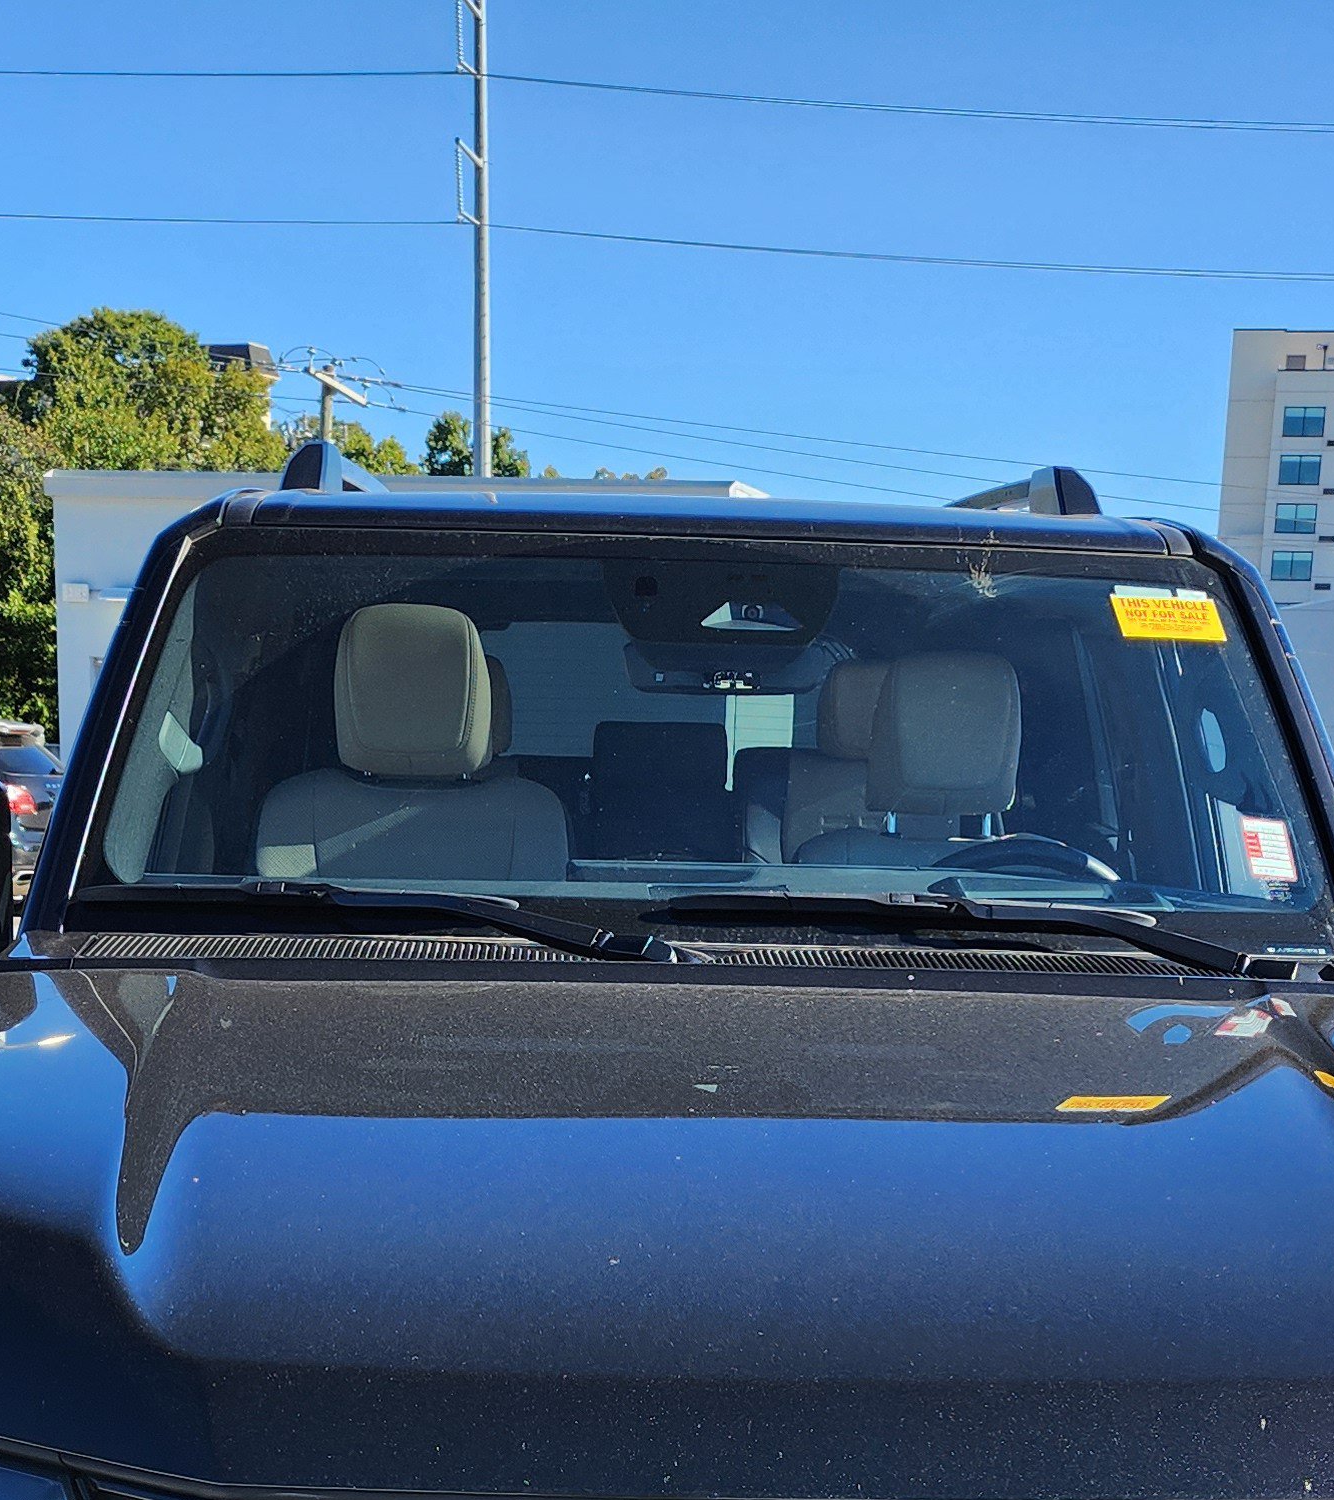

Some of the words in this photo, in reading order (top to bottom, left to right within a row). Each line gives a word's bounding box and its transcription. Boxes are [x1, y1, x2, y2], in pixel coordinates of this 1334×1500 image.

[1118, 597, 1150, 609] THIS
[1152, 599, 1210, 611] VEHICLE
[1124, 609, 1148, 618] NOT
[1152, 610, 1176, 619] FOR
[1179, 611, 1209, 620] SALE
